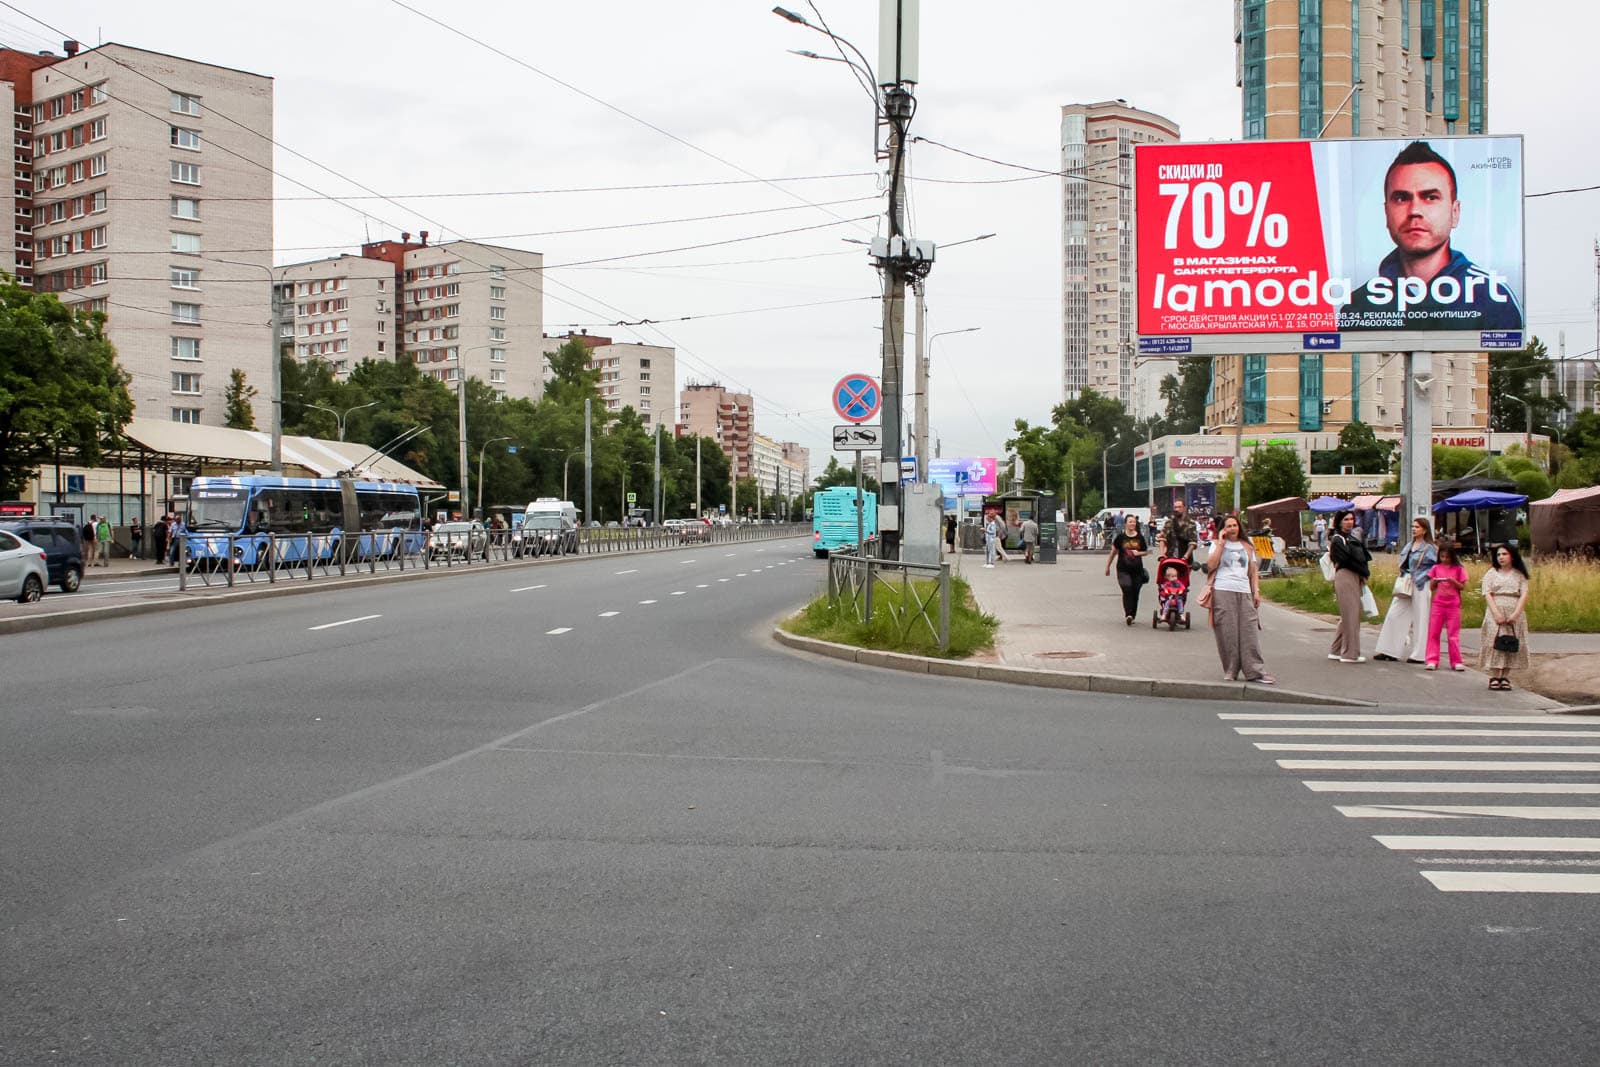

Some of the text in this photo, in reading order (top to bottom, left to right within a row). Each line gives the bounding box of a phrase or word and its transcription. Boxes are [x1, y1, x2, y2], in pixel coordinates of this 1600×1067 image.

[1158, 163, 1223, 180] СКИДКИ ДО
[1159, 181, 1289, 250] 70%
[1173, 256, 1277, 266] В МАГАЗИНАХ
[1173, 266, 1298, 275] САНКТ-ПЕТЕРБУРГА
[1152, 270, 1508, 312] lamoda sport
[1189, 313, 1237, 323] ДЕЙСТВИЯ
[1238, 313, 1269, 322] АКЦИИ
[1309, 312, 1323, 320] ПО
[1363, 311, 1407, 319] РЕКЛАМА
[1407, 311, 1428, 319] ООО
[1429, 310, 1482, 319] «КУПИШУЗ»
[1441, 436, 1485, 447] КАМНЕЙ
[1178, 456, 1225, 467] Теремок
